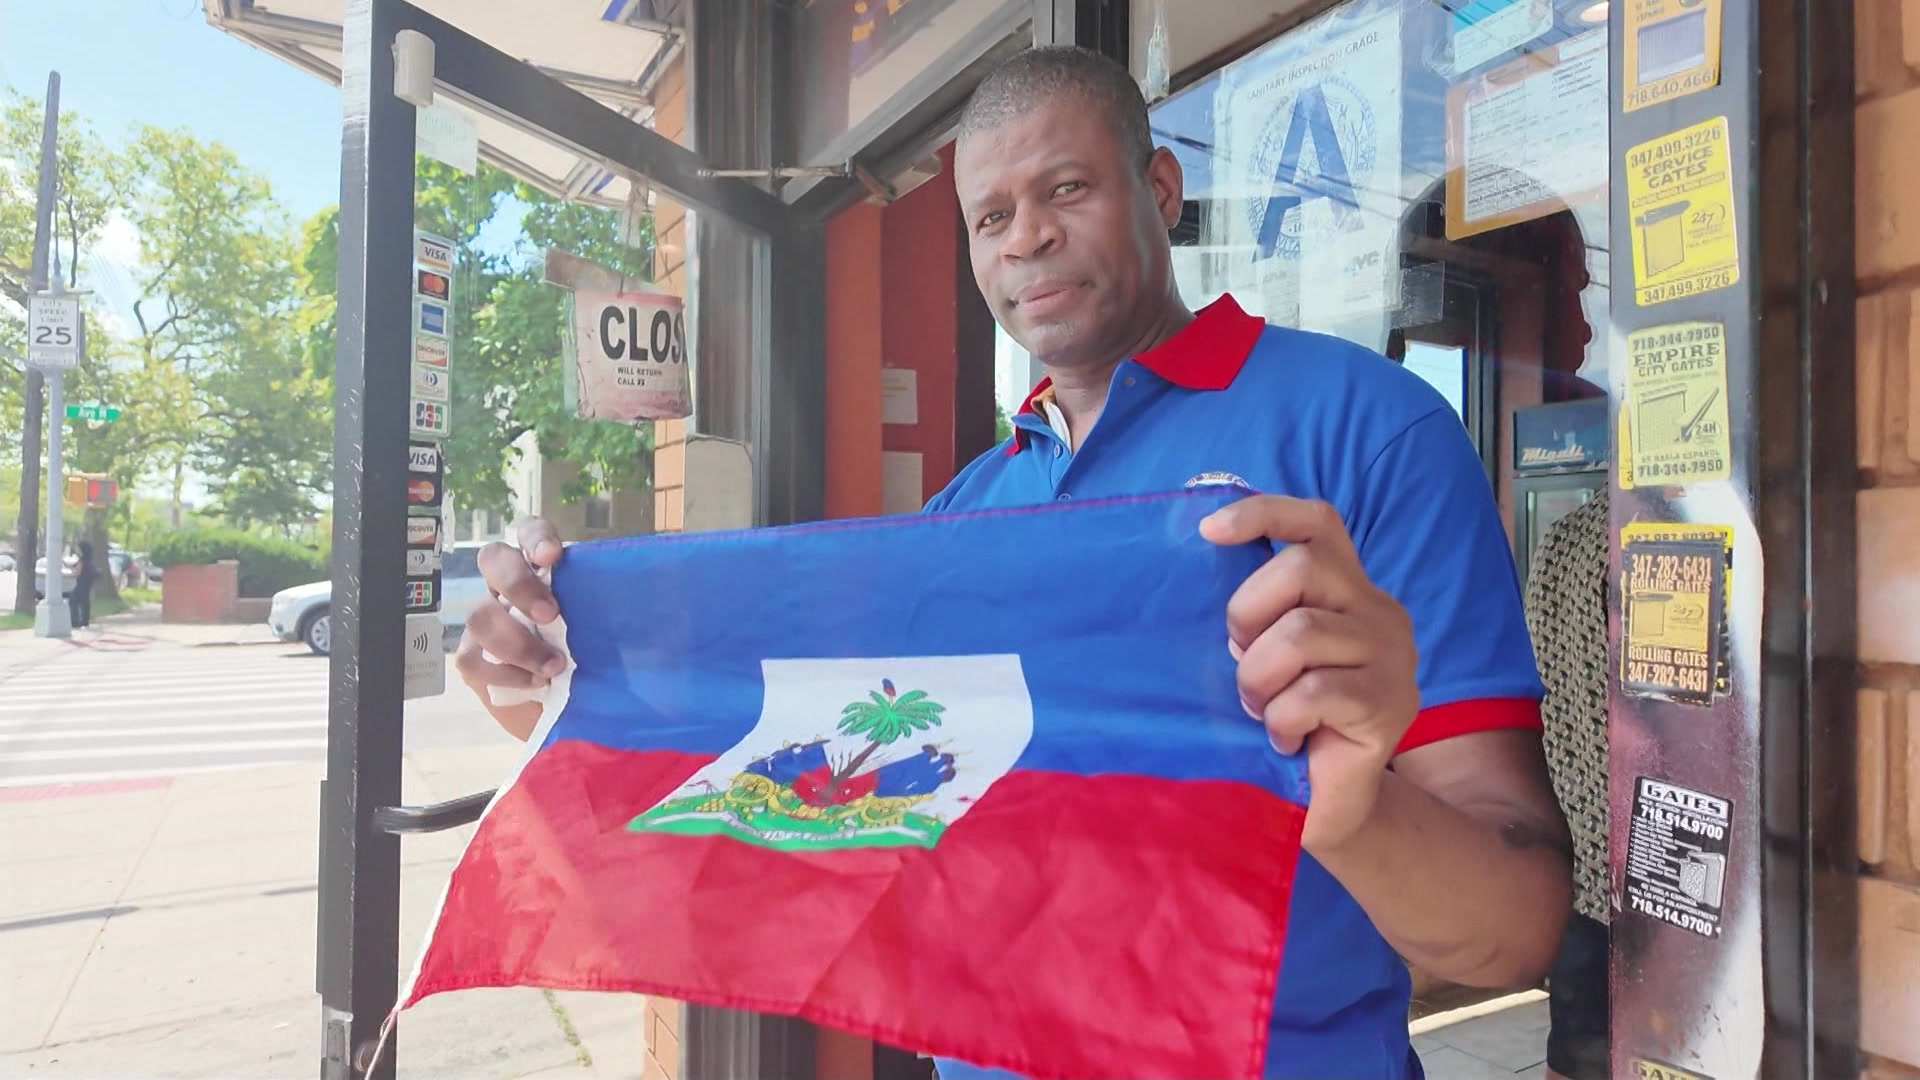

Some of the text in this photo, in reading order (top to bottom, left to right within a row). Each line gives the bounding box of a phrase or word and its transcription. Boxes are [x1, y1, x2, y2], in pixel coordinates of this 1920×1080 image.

[1287, 49, 1343, 83] INSPECTION
[1345, 31, 1379, 54] GRADE
[1251, 83, 1365, 264] A
[1642, 145, 1714, 179] SERVICE
[1648, 160, 1708, 189] GATES
[424, 246, 447, 261] VISA
[35, 325, 72, 346] 25
[600, 305, 687, 364] CLOS
[1634, 343, 1720, 368] EMPIRE
[1638, 357, 1714, 377] CITY GATES
[617, 366, 635, 375] WILL
[617, 377, 635, 386] CALL
[1632, 553, 1712, 582] 347-282-6431
[1631, 577, 1710, 593] ROLLING GATES
[1628, 646, 1709, 668] ROLLING GATES
[1628, 662, 1709, 692] 347-282-6431
[1647, 783, 1722, 815] GATES
[1640, 804, 1724, 840] 718.514.9700
[1631, 895, 1713, 936] 718.514.9700
